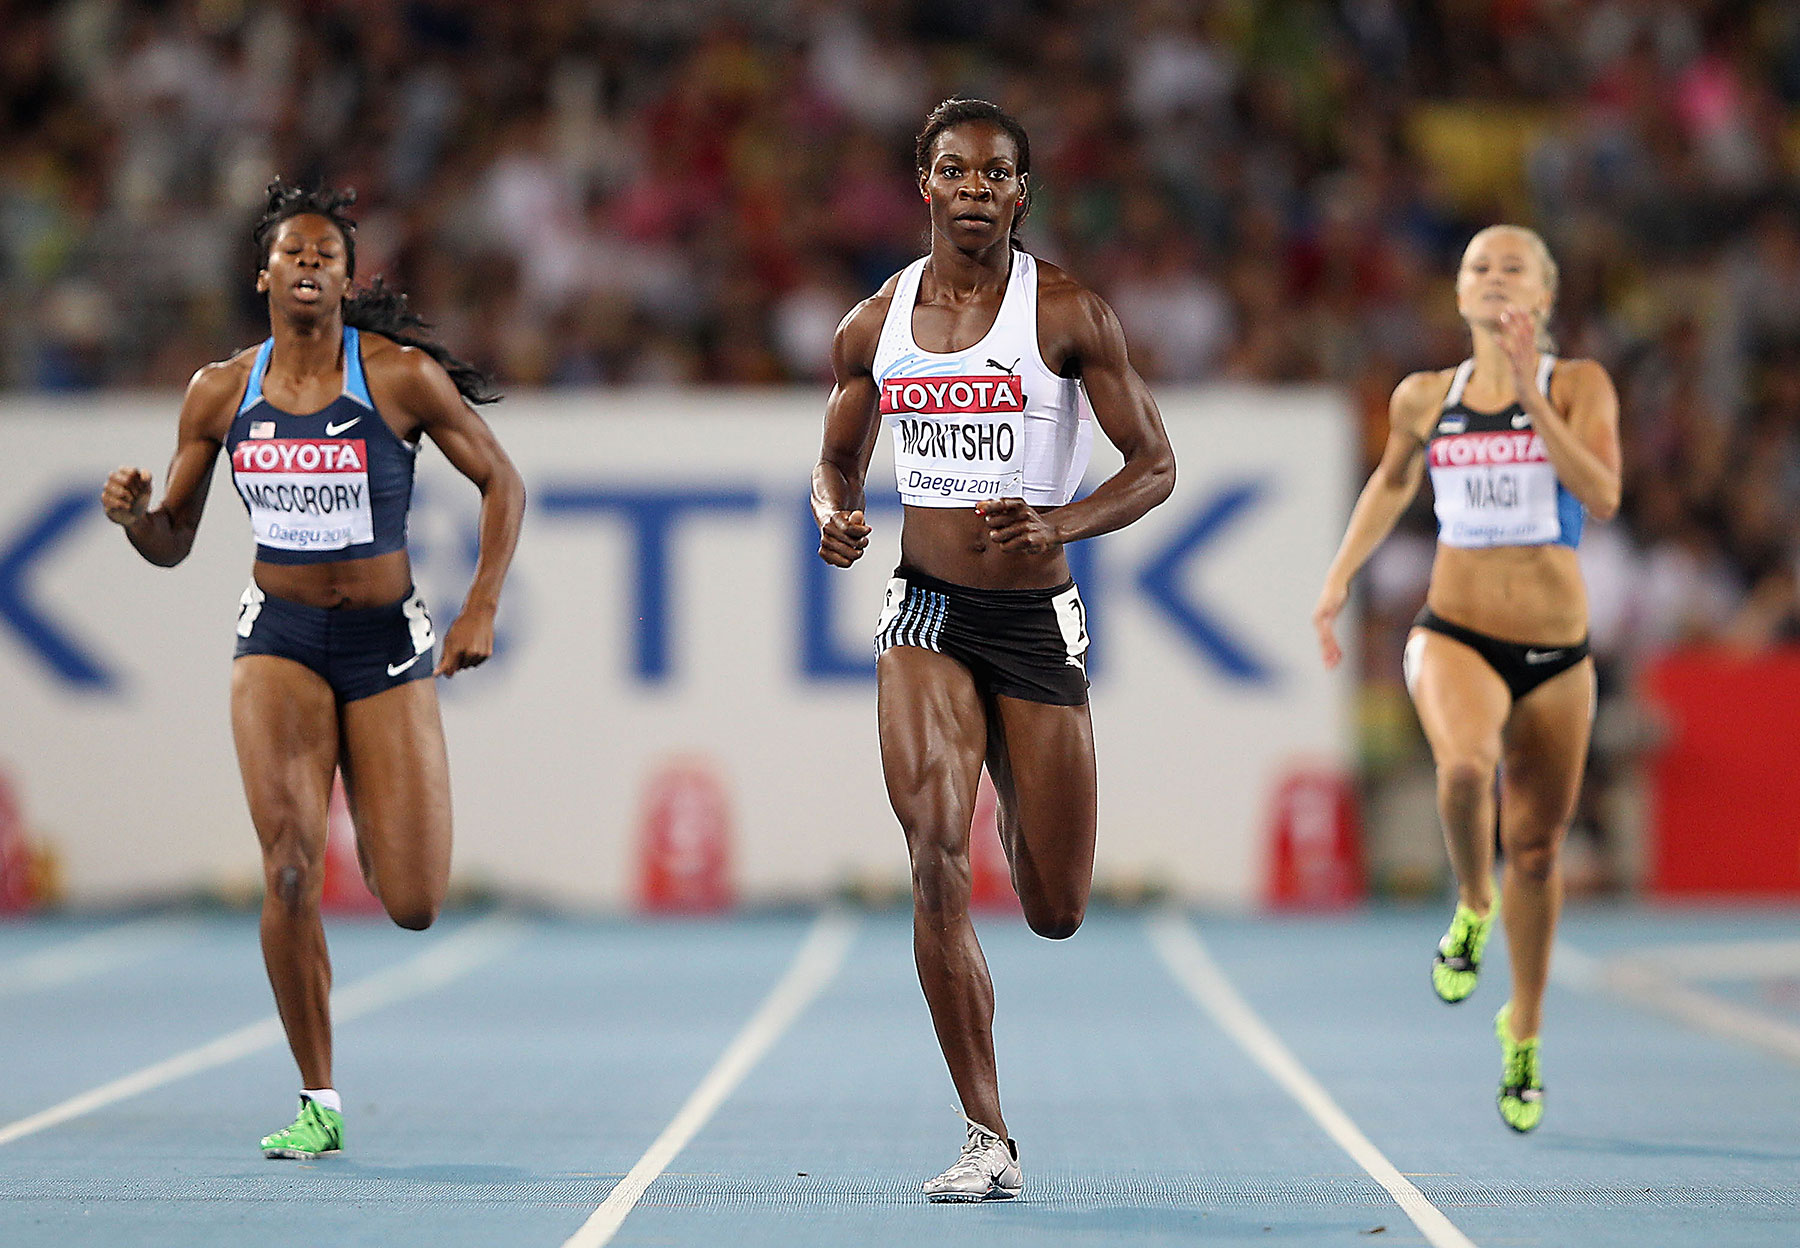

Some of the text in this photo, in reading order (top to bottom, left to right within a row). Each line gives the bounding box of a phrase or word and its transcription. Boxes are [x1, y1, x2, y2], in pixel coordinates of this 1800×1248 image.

[887, 381, 1018, 410] TOYOTA
[898, 418, 1014, 462] MONTSHO
[1433, 435, 1548, 465] TOYOTA
[240, 444, 362, 470] TOYOTA
[908, 470, 1001, 496] Daegu 2011
[245, 483, 362, 516] MCCORORY
[269, 523, 321, 546] Daegu
